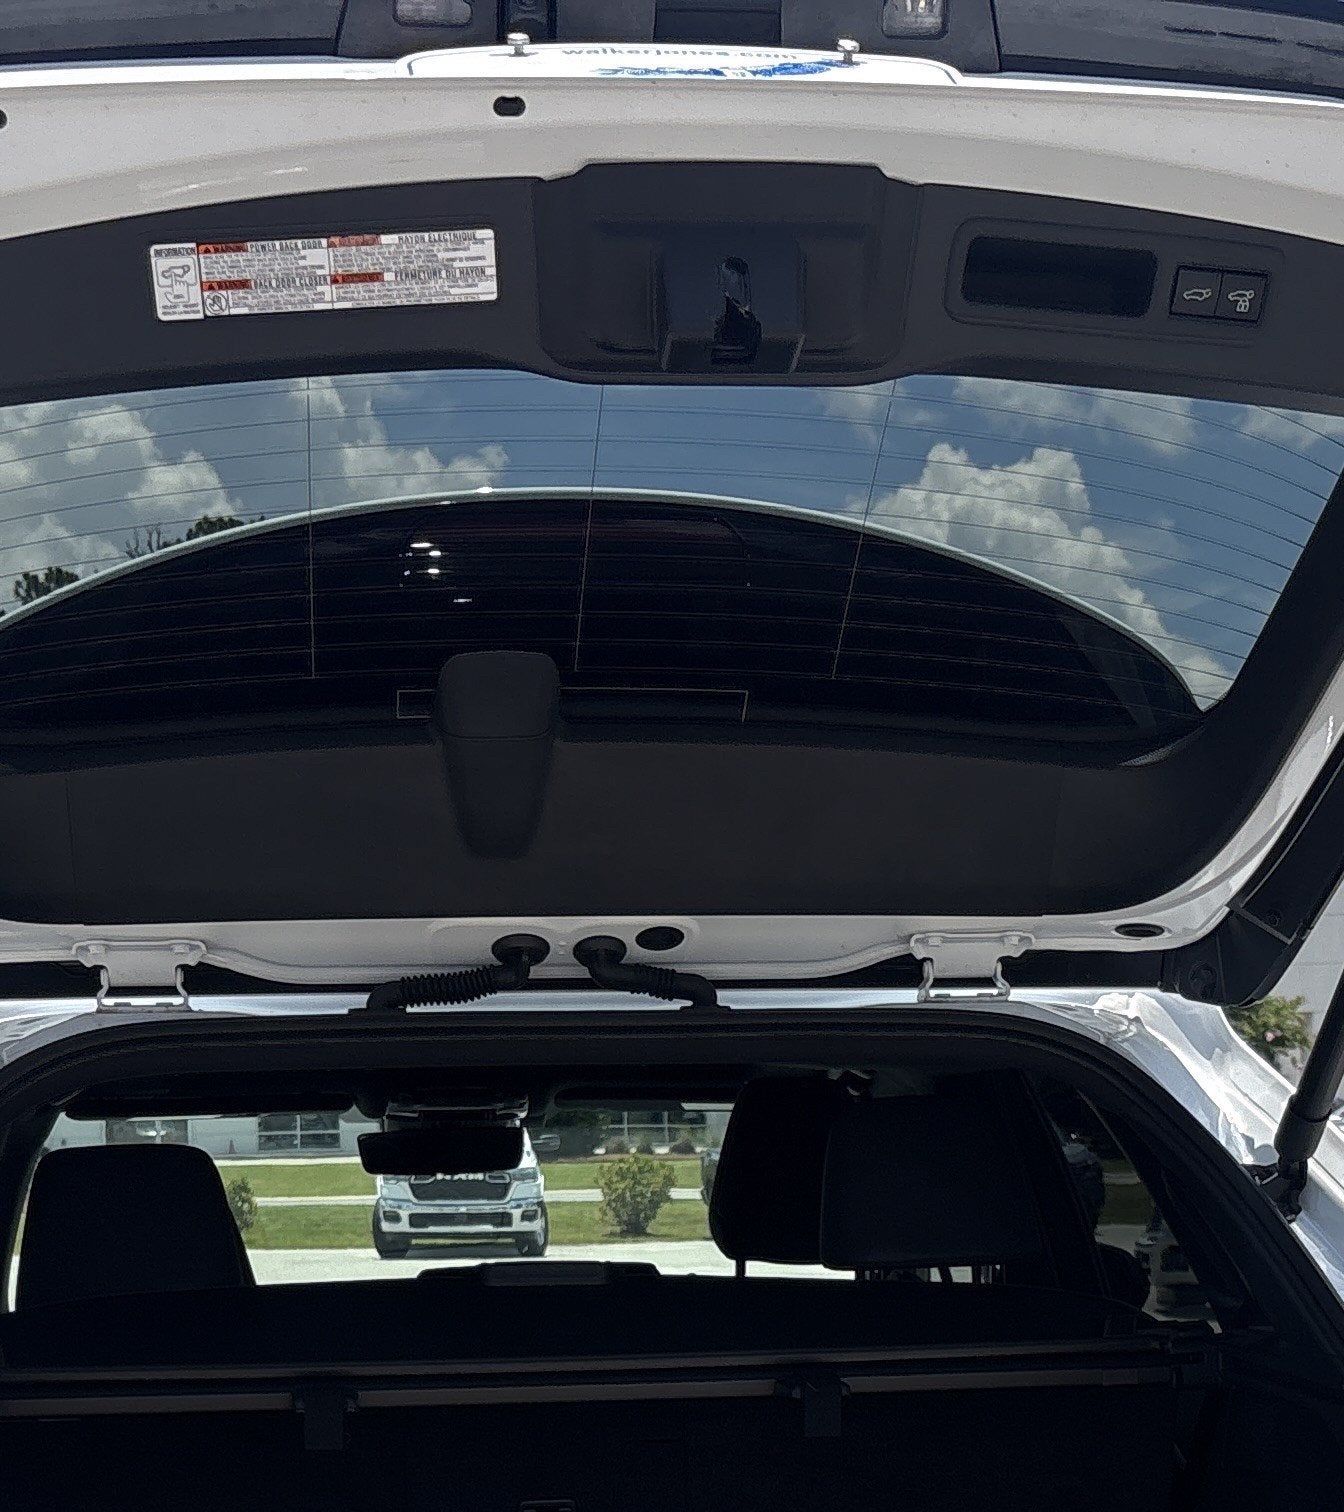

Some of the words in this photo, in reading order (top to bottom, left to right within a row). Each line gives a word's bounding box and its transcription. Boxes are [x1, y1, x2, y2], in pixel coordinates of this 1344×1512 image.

[249, 240, 277, 251] POWER
[279, 240, 299, 250] BACK
[301, 239, 323, 249] DOOR
[276, 276, 297, 287] DOOR
[300, 275, 329, 287] CLOSER
